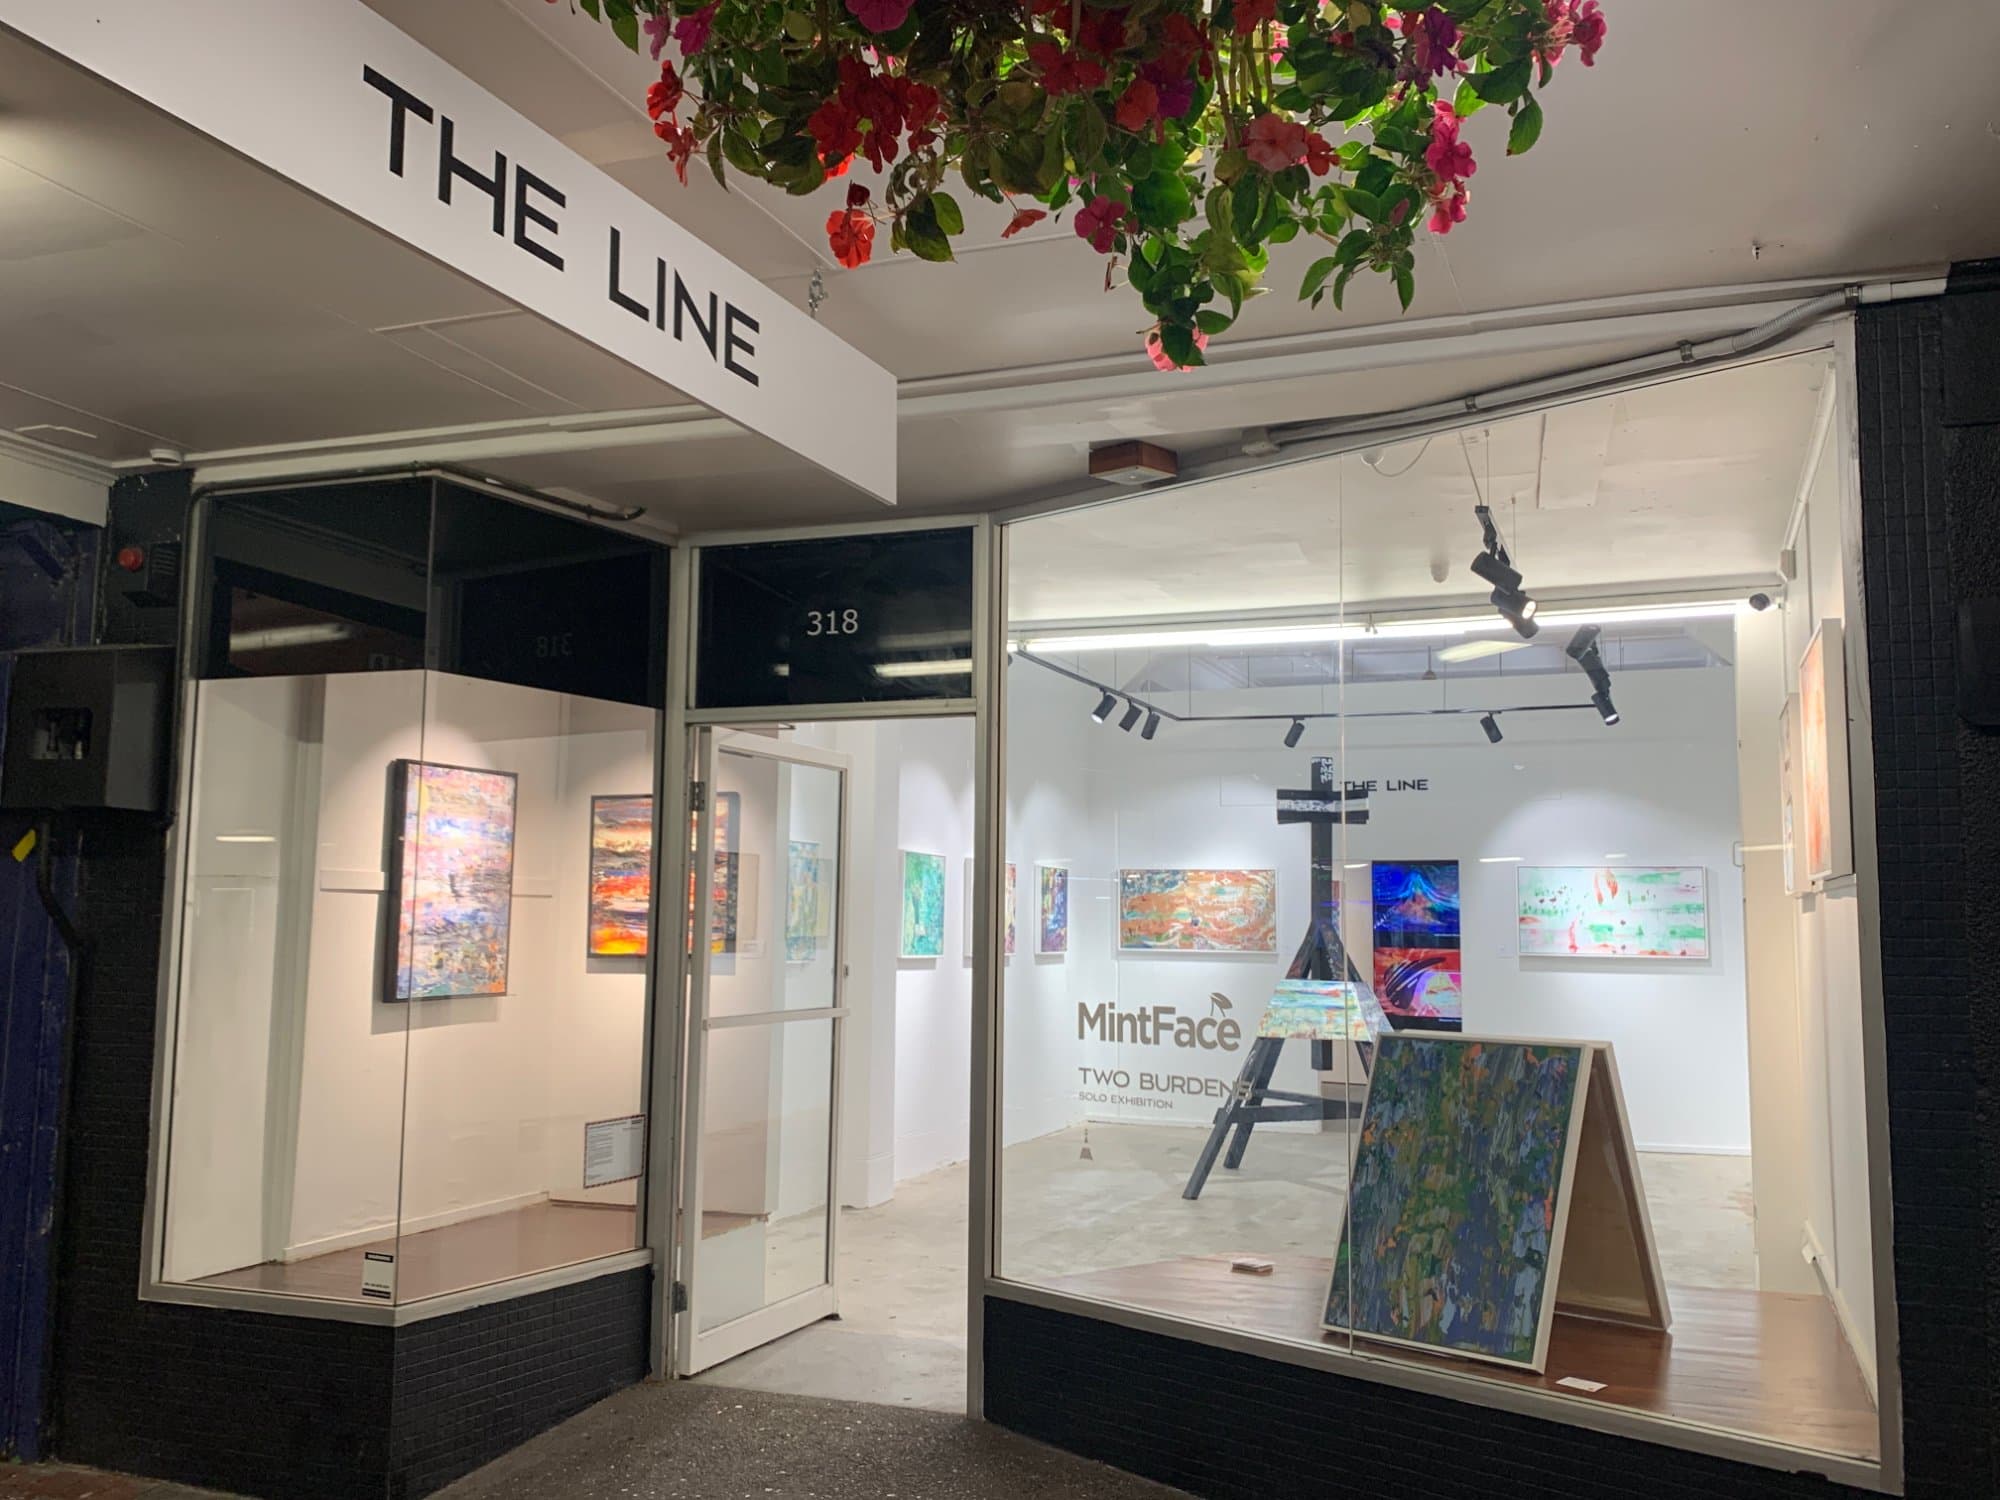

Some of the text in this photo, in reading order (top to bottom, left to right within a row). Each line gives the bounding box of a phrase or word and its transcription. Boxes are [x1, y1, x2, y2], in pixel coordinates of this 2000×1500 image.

[363, 64, 760, 387] THE LINE
[807, 609, 858, 636] 318
[1339, 779, 1428, 792] THE LINE
[1078, 1002, 1241, 1051] MintFace
[1078, 1067, 1130, 1088] TWO
[1079, 1091, 1173, 1109] SOLO EXHIBITION
